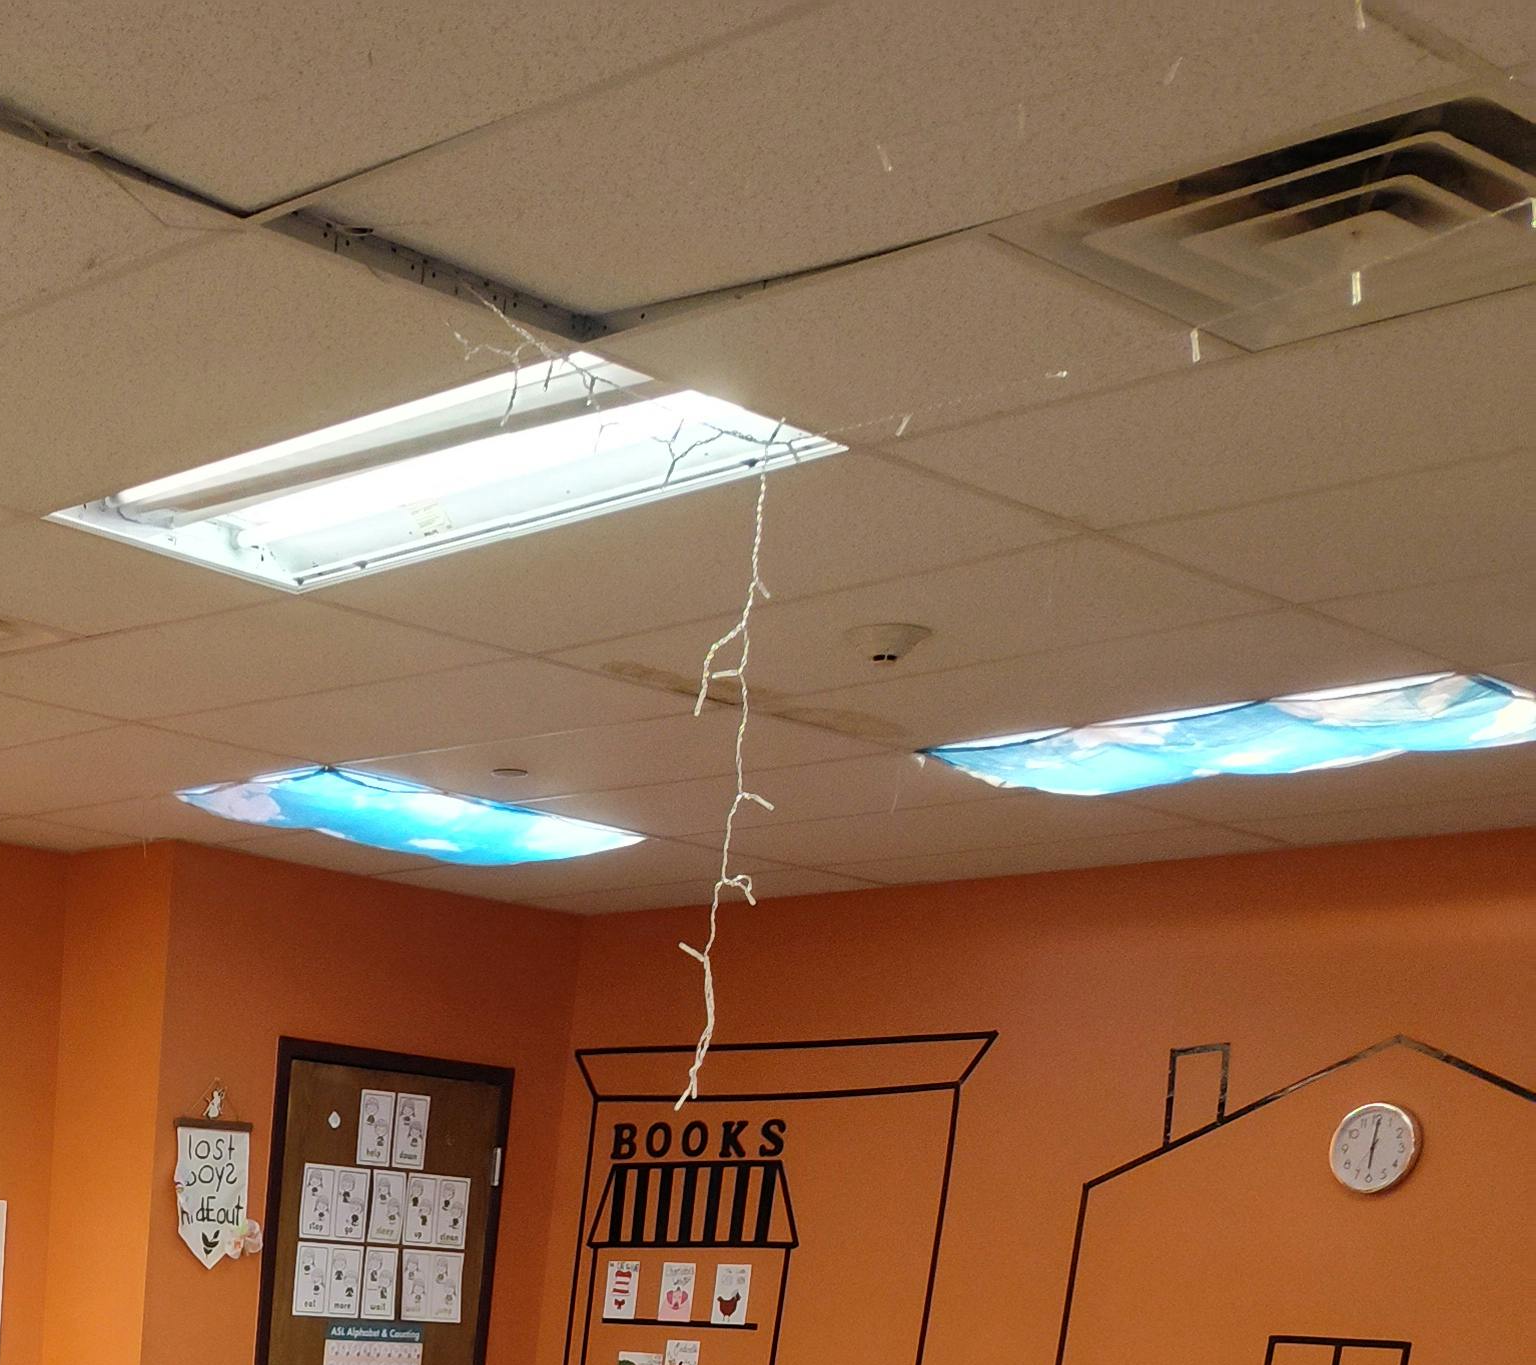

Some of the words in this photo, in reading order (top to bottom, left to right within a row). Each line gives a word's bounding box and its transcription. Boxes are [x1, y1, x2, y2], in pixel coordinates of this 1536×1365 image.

[611, 1119, 786, 1159] BOOKS
[331, 1326, 346, 1337] ASL
[346, 1326, 380, 1339] Alphabet
[381, 1328, 388, 1338] &
[389, 1328, 421, 1342] Counting
